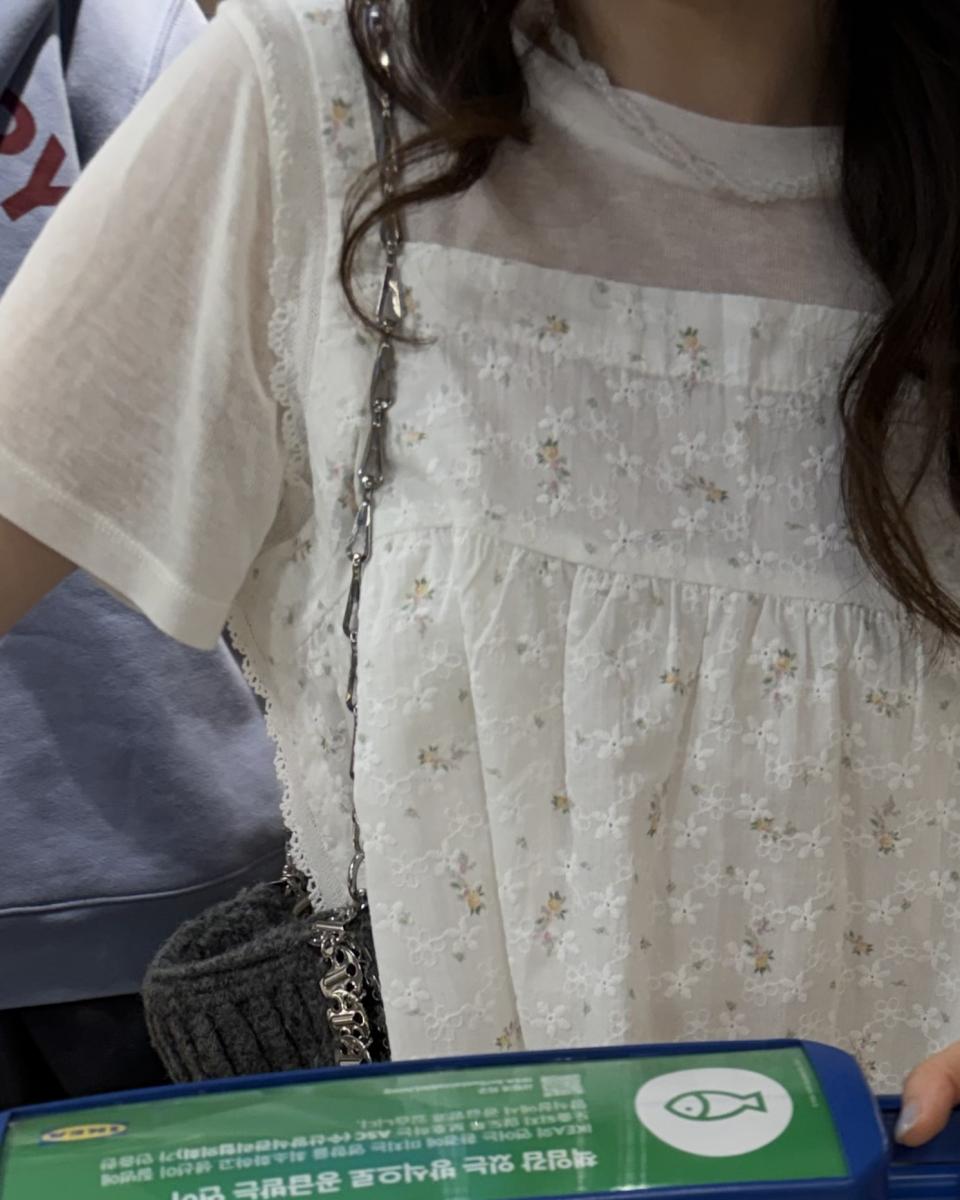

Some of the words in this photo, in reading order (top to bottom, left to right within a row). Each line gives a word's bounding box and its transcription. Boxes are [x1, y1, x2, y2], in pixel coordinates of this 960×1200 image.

[355, 1129, 391, 1142] ASC
[483, 1128, 531, 1142] 연어는
[537, 1124, 592, 1139] IKEA의
[370, 1138, 421, 1153] 미치는
[427, 1133, 476, 1149] 환경에
[100, 1152, 154, 1170] 인증한
[218, 1150, 306, 1171] 최소화하고
[312, 1145, 366, 1160] 영향을
[521, 1148, 598, 1172] 책임감
[160, 1160, 212, 1179] 생선이
[463, 1153, 514, 1174] 있는
[100, 1168, 154, 1187] 질병에
[349, 1159, 456, 1188] 방식으로
[233, 1171, 342, 1200] 공급받는
